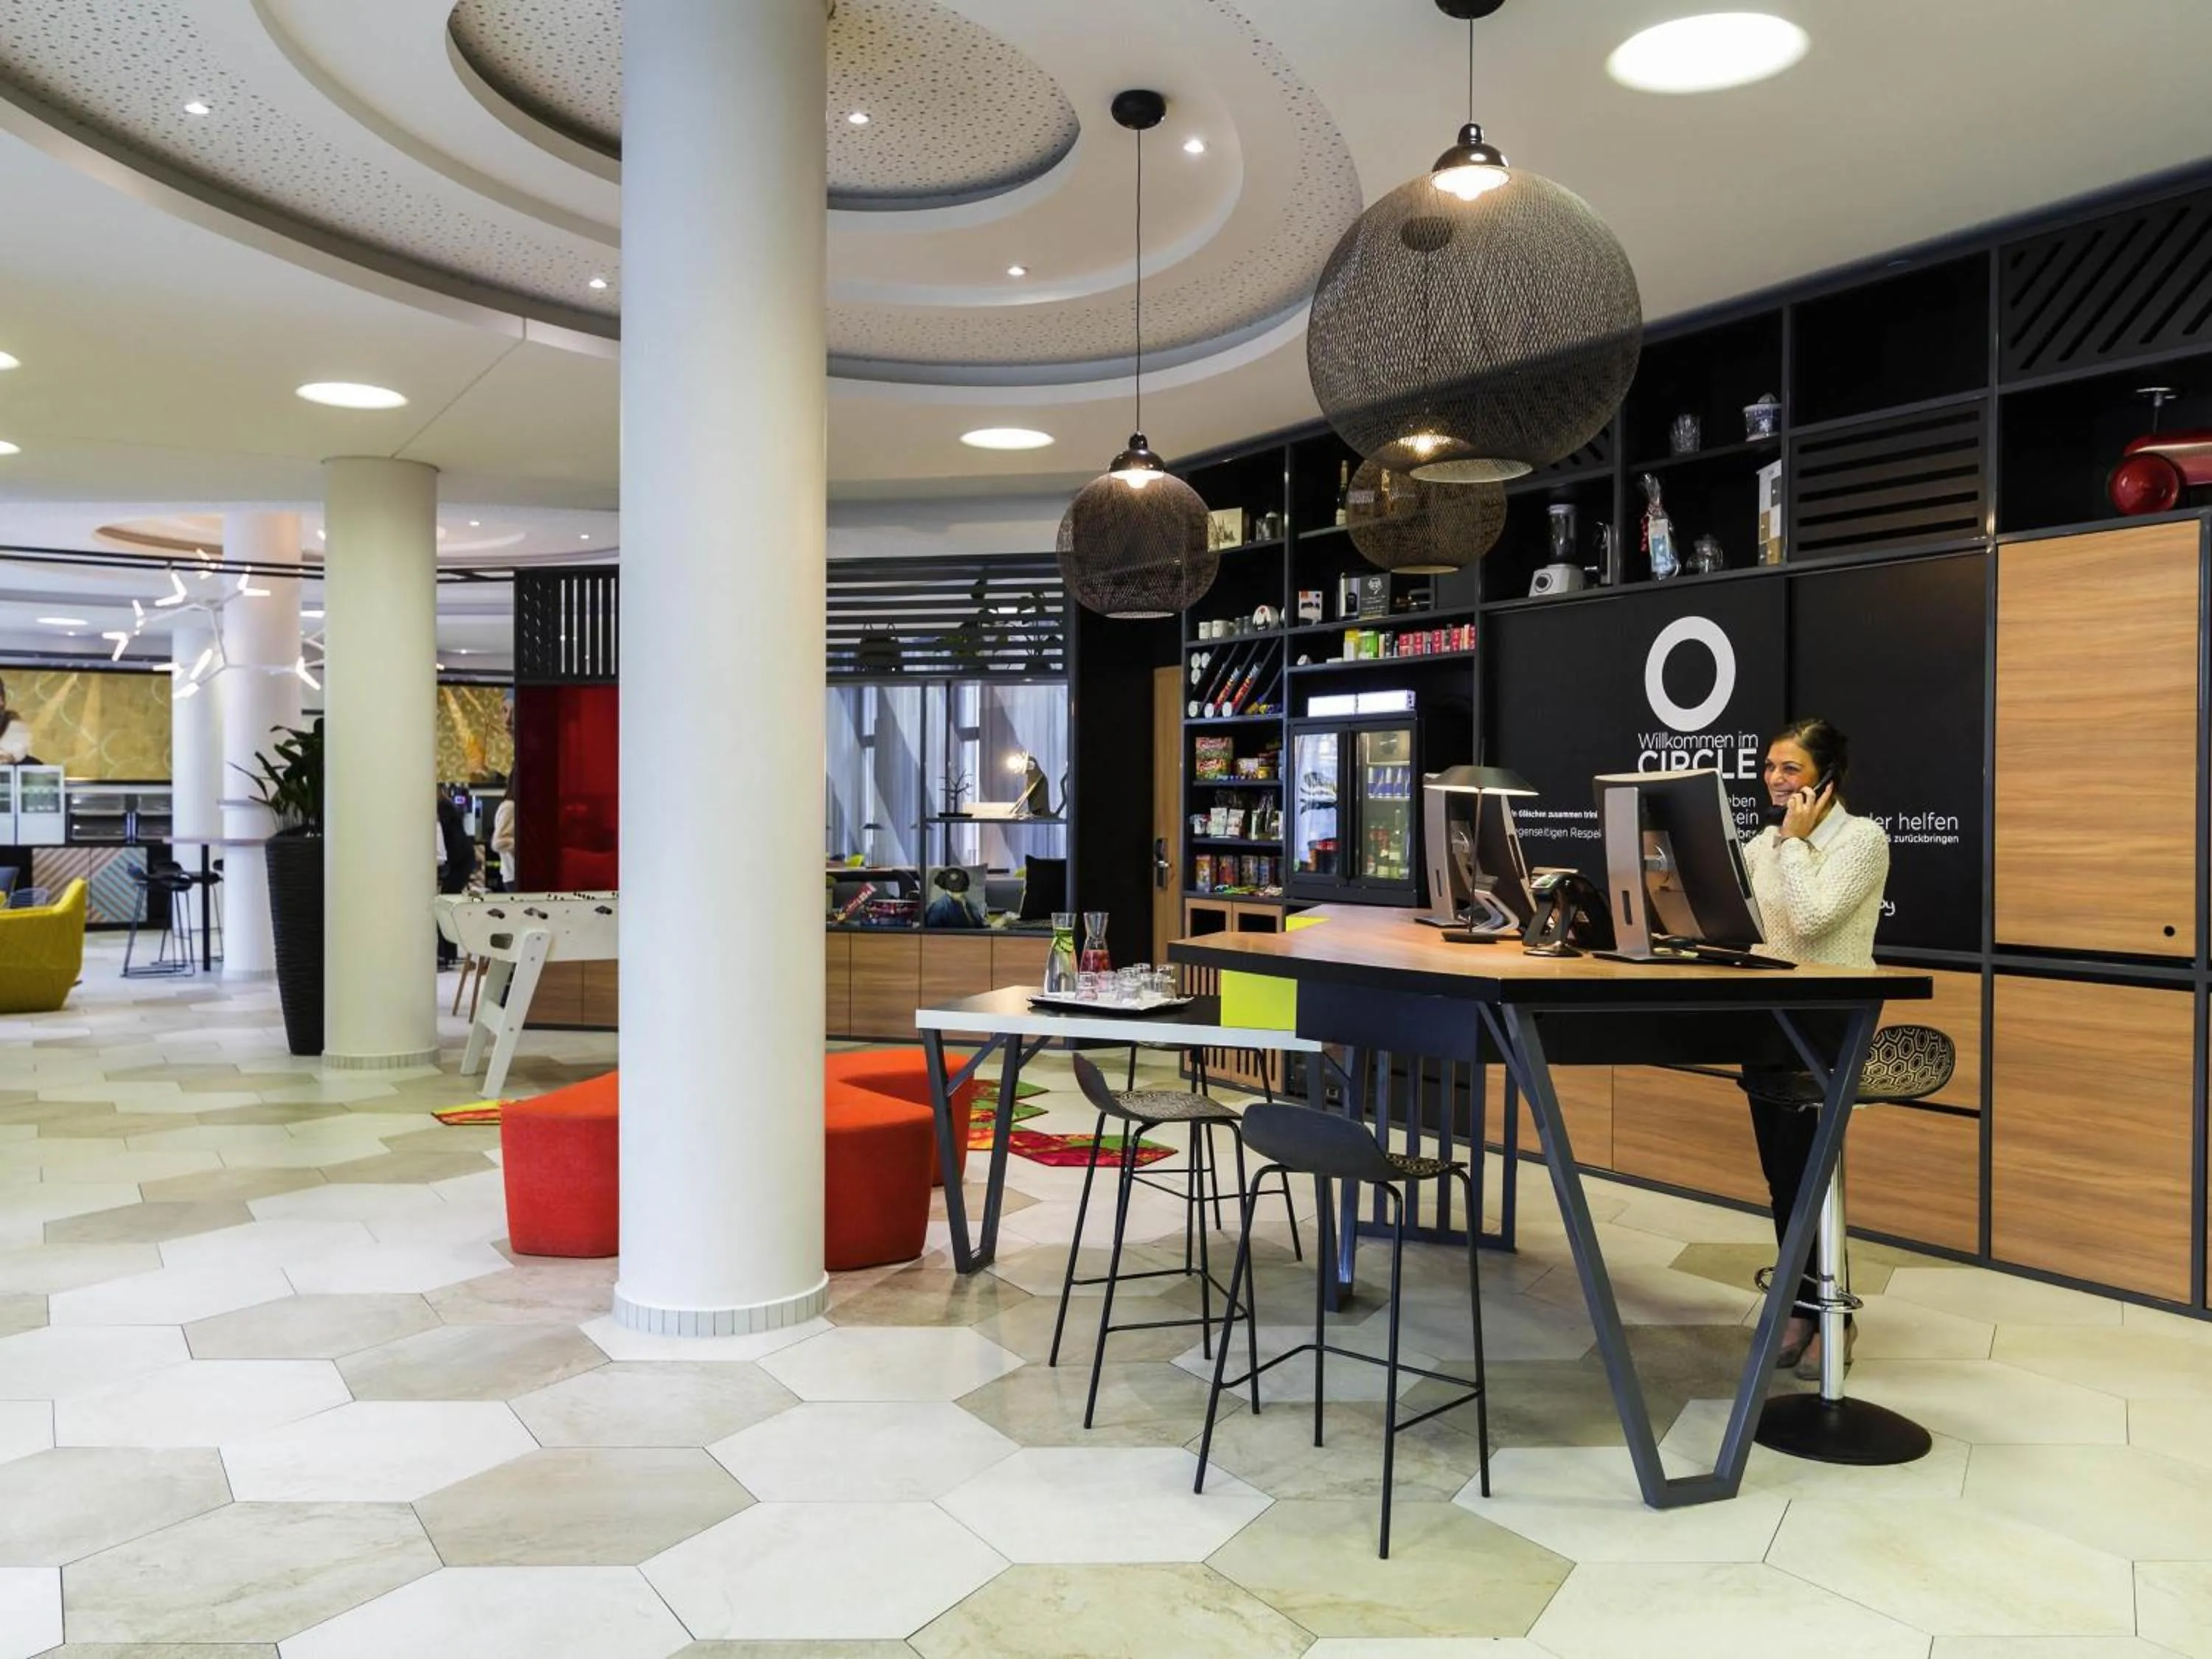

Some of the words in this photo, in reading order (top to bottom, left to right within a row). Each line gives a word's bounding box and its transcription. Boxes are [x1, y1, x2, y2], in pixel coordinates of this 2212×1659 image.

[1638, 732, 1733, 750] Willkommen
[1738, 731, 1759, 748] im
[1899, 812, 1959, 830] helfen
[1894, 833, 1959, 845] zurückbringen
